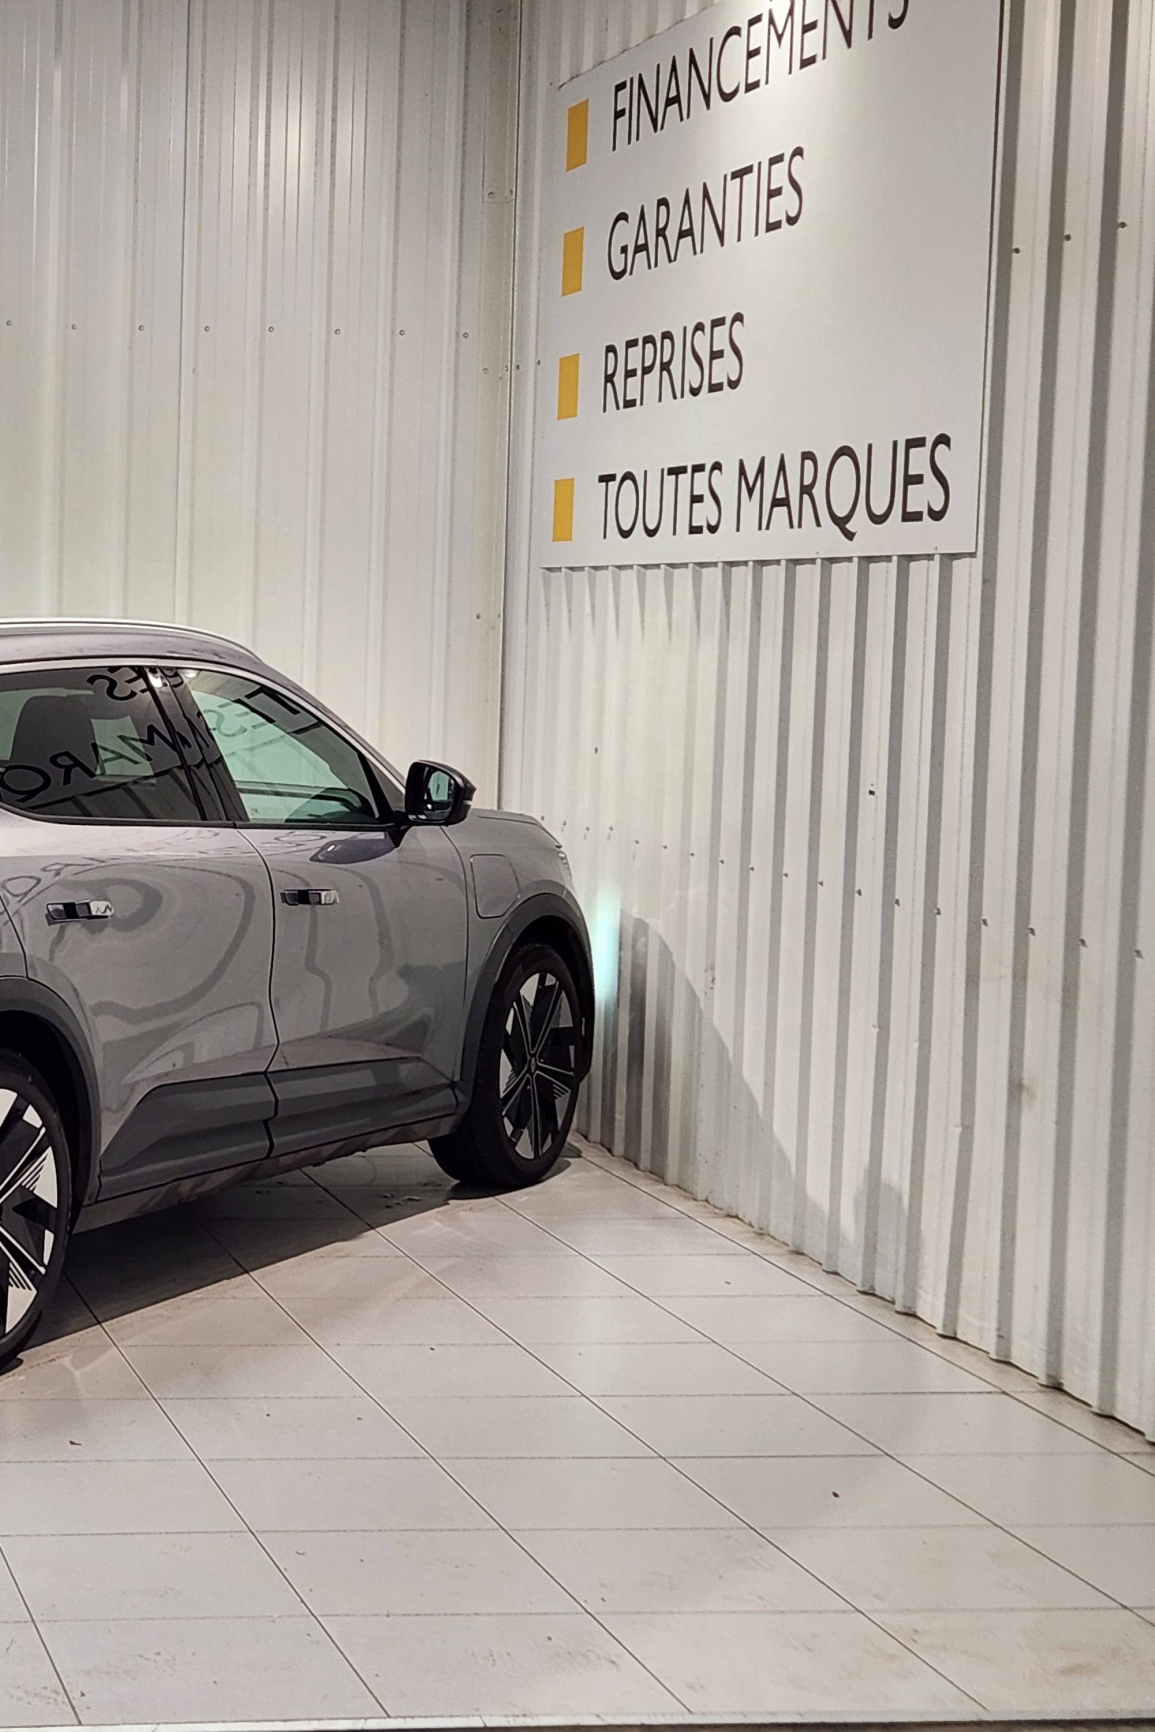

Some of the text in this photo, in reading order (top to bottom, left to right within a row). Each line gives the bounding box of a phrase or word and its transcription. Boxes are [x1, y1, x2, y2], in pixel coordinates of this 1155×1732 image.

[607, 146, 805, 281] GARANTIES
[602, 311, 745, 413] REPRISES
[598, 433, 952, 542] TOUTES MARQUES
